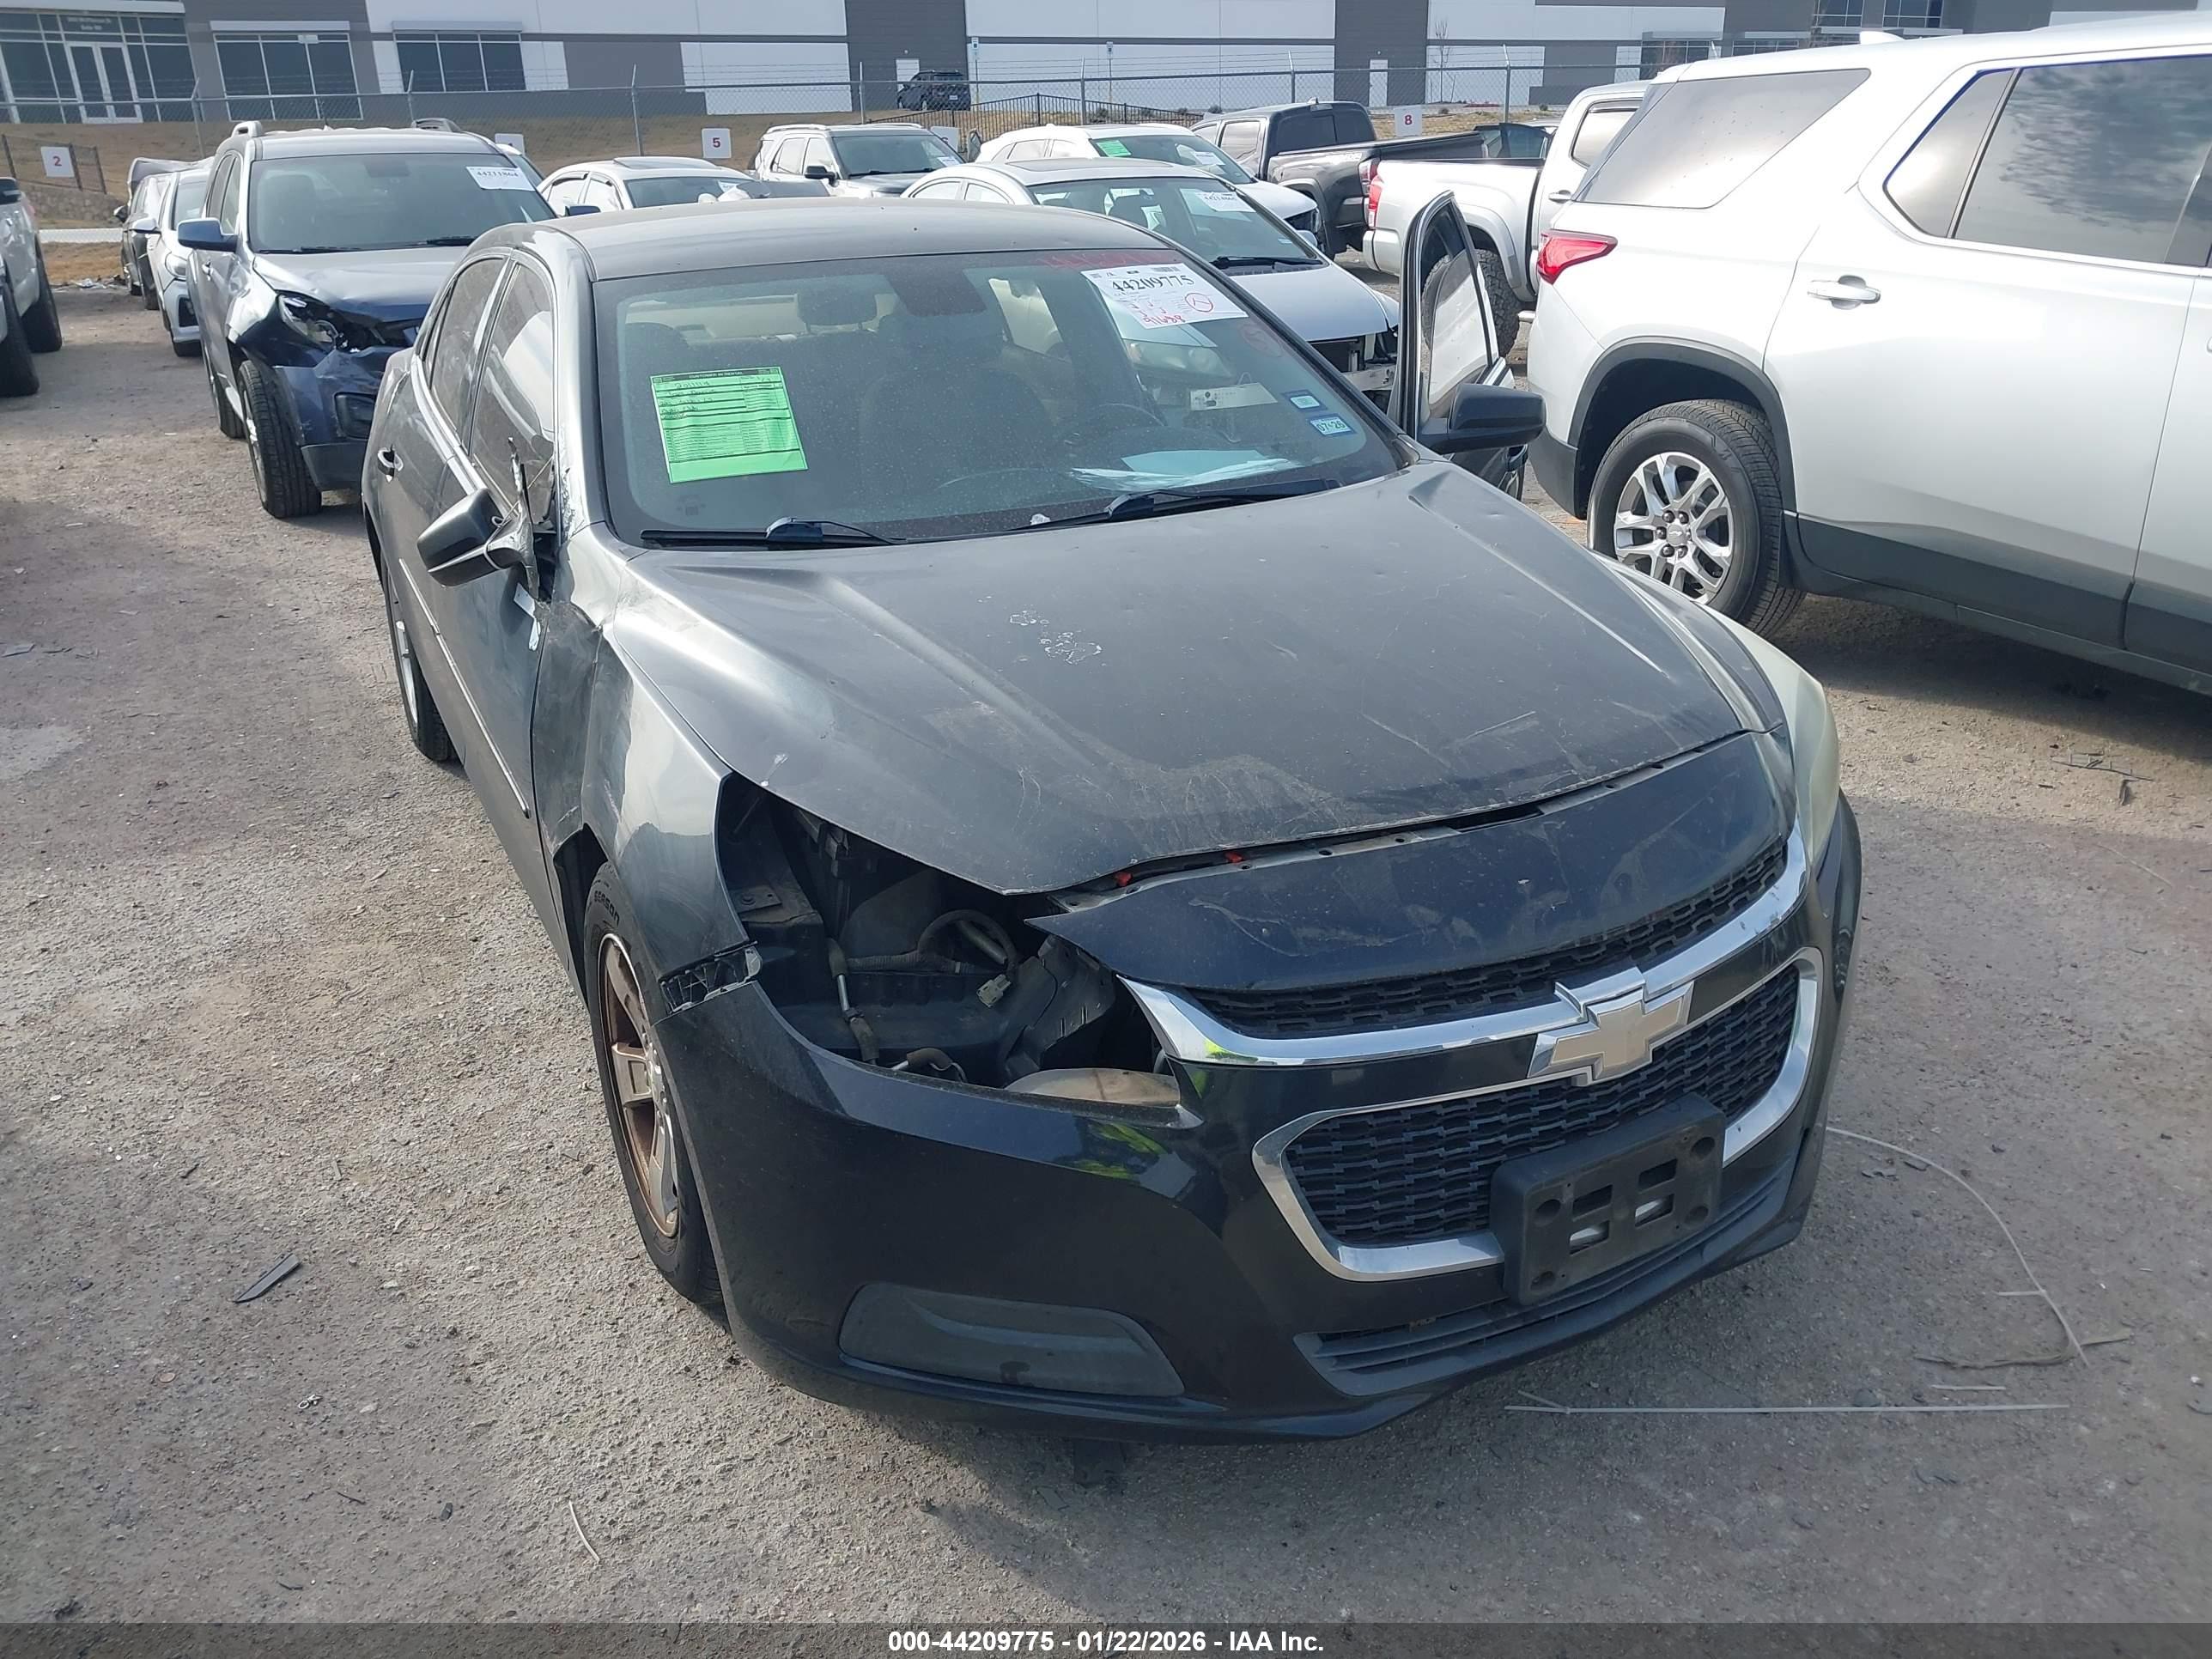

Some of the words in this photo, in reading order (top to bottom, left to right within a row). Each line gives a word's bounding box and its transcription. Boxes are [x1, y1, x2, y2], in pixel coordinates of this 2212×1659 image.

[1404, 114, 1413, 125] 8
[712, 137, 721, 149] 5
[52, 155, 63, 167] 2
[1112, 275, 1194, 292] 44209775
